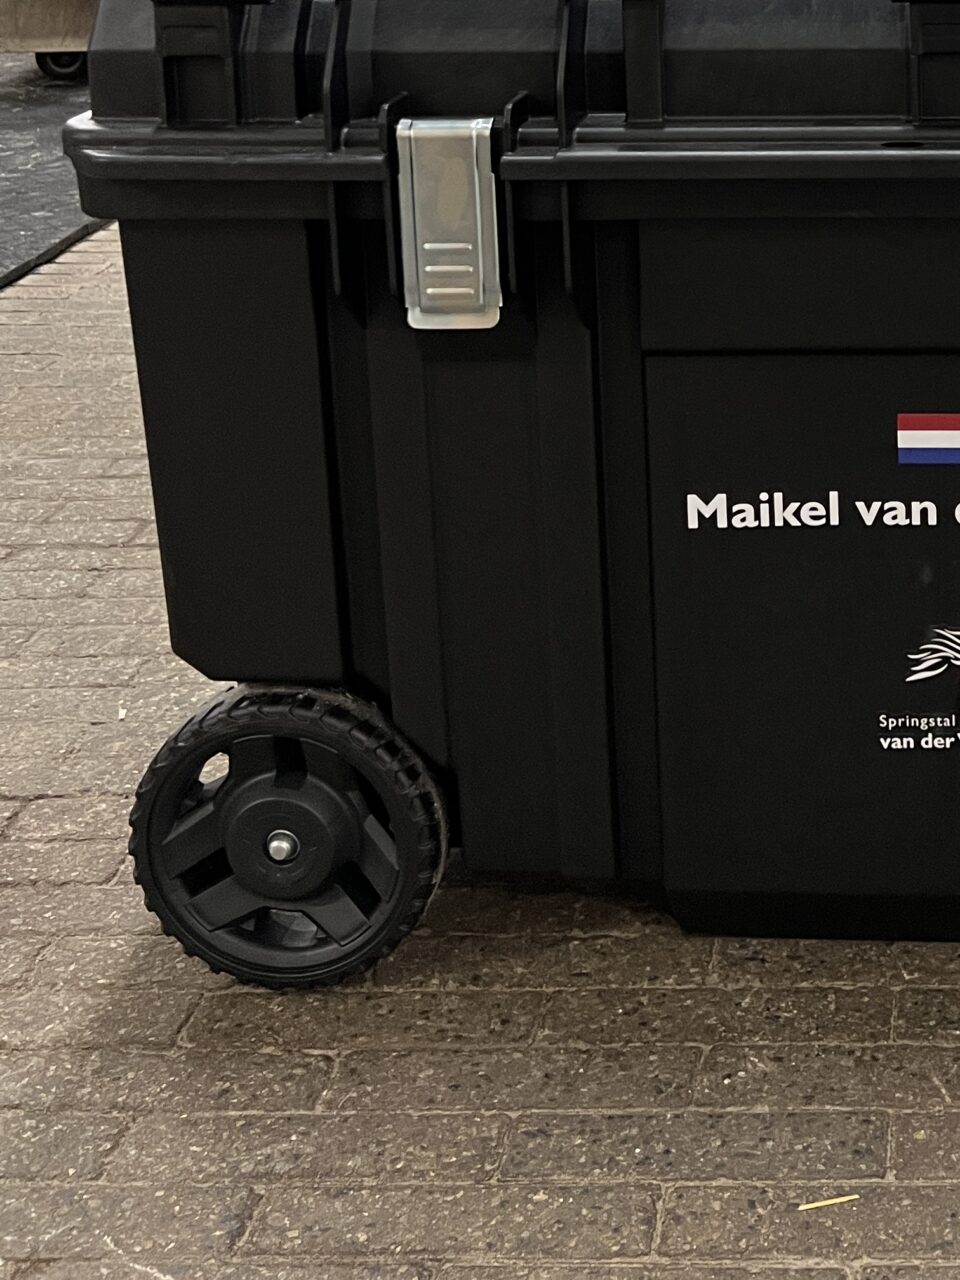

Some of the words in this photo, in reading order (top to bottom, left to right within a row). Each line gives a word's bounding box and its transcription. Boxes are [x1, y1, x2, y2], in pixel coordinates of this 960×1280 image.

[686, 491, 840, 530] Maikel
[855, 500, 938, 527] van
[879, 714, 956, 731] Springstal
[879, 736, 915, 750] van
[920, 732, 956, 750] der
